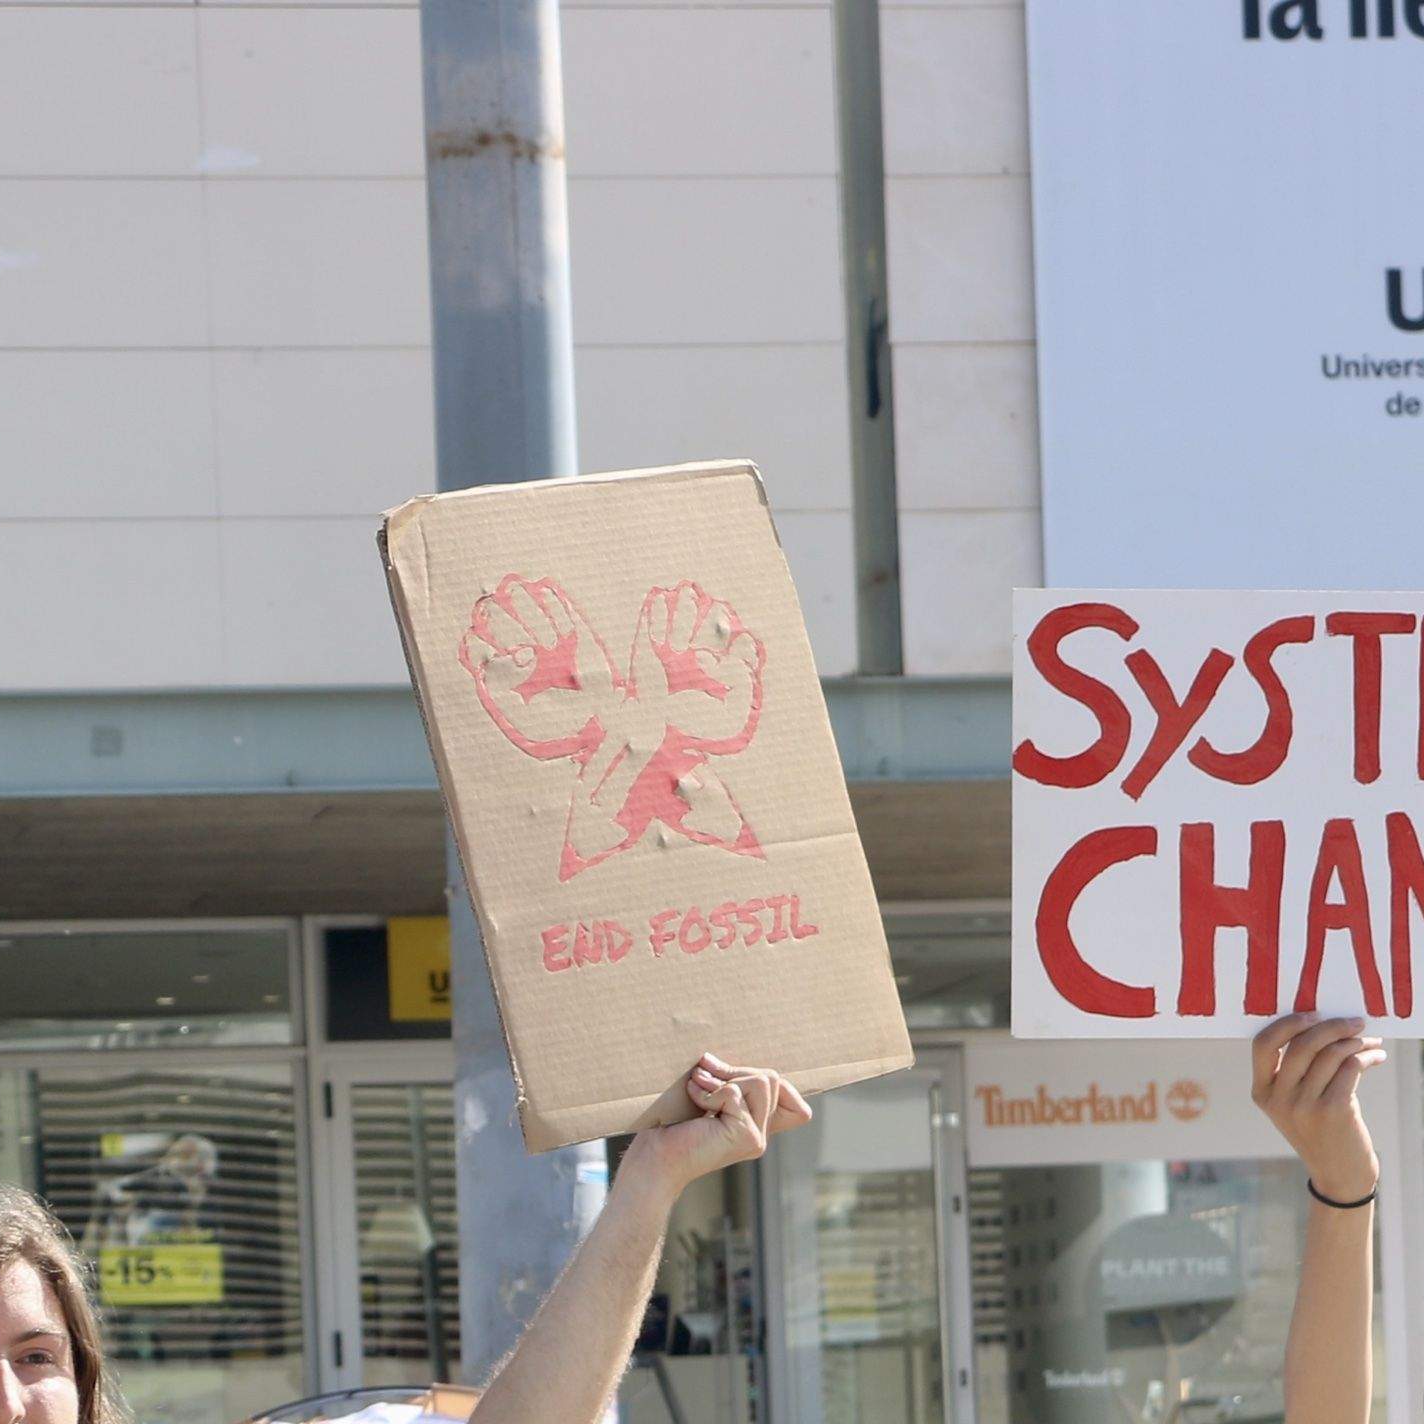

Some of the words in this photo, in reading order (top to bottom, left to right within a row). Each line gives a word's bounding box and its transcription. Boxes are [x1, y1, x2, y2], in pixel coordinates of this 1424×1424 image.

[1386, 393, 1421, 416] de
[540, 917, 635, 973] END
[648, 893, 820, 958] FOSSIL
[974, 1080, 1159, 1128] Timberland
[1099, 1258, 1179, 1280] PLANT
[1182, 1256, 1229, 1277] THE
